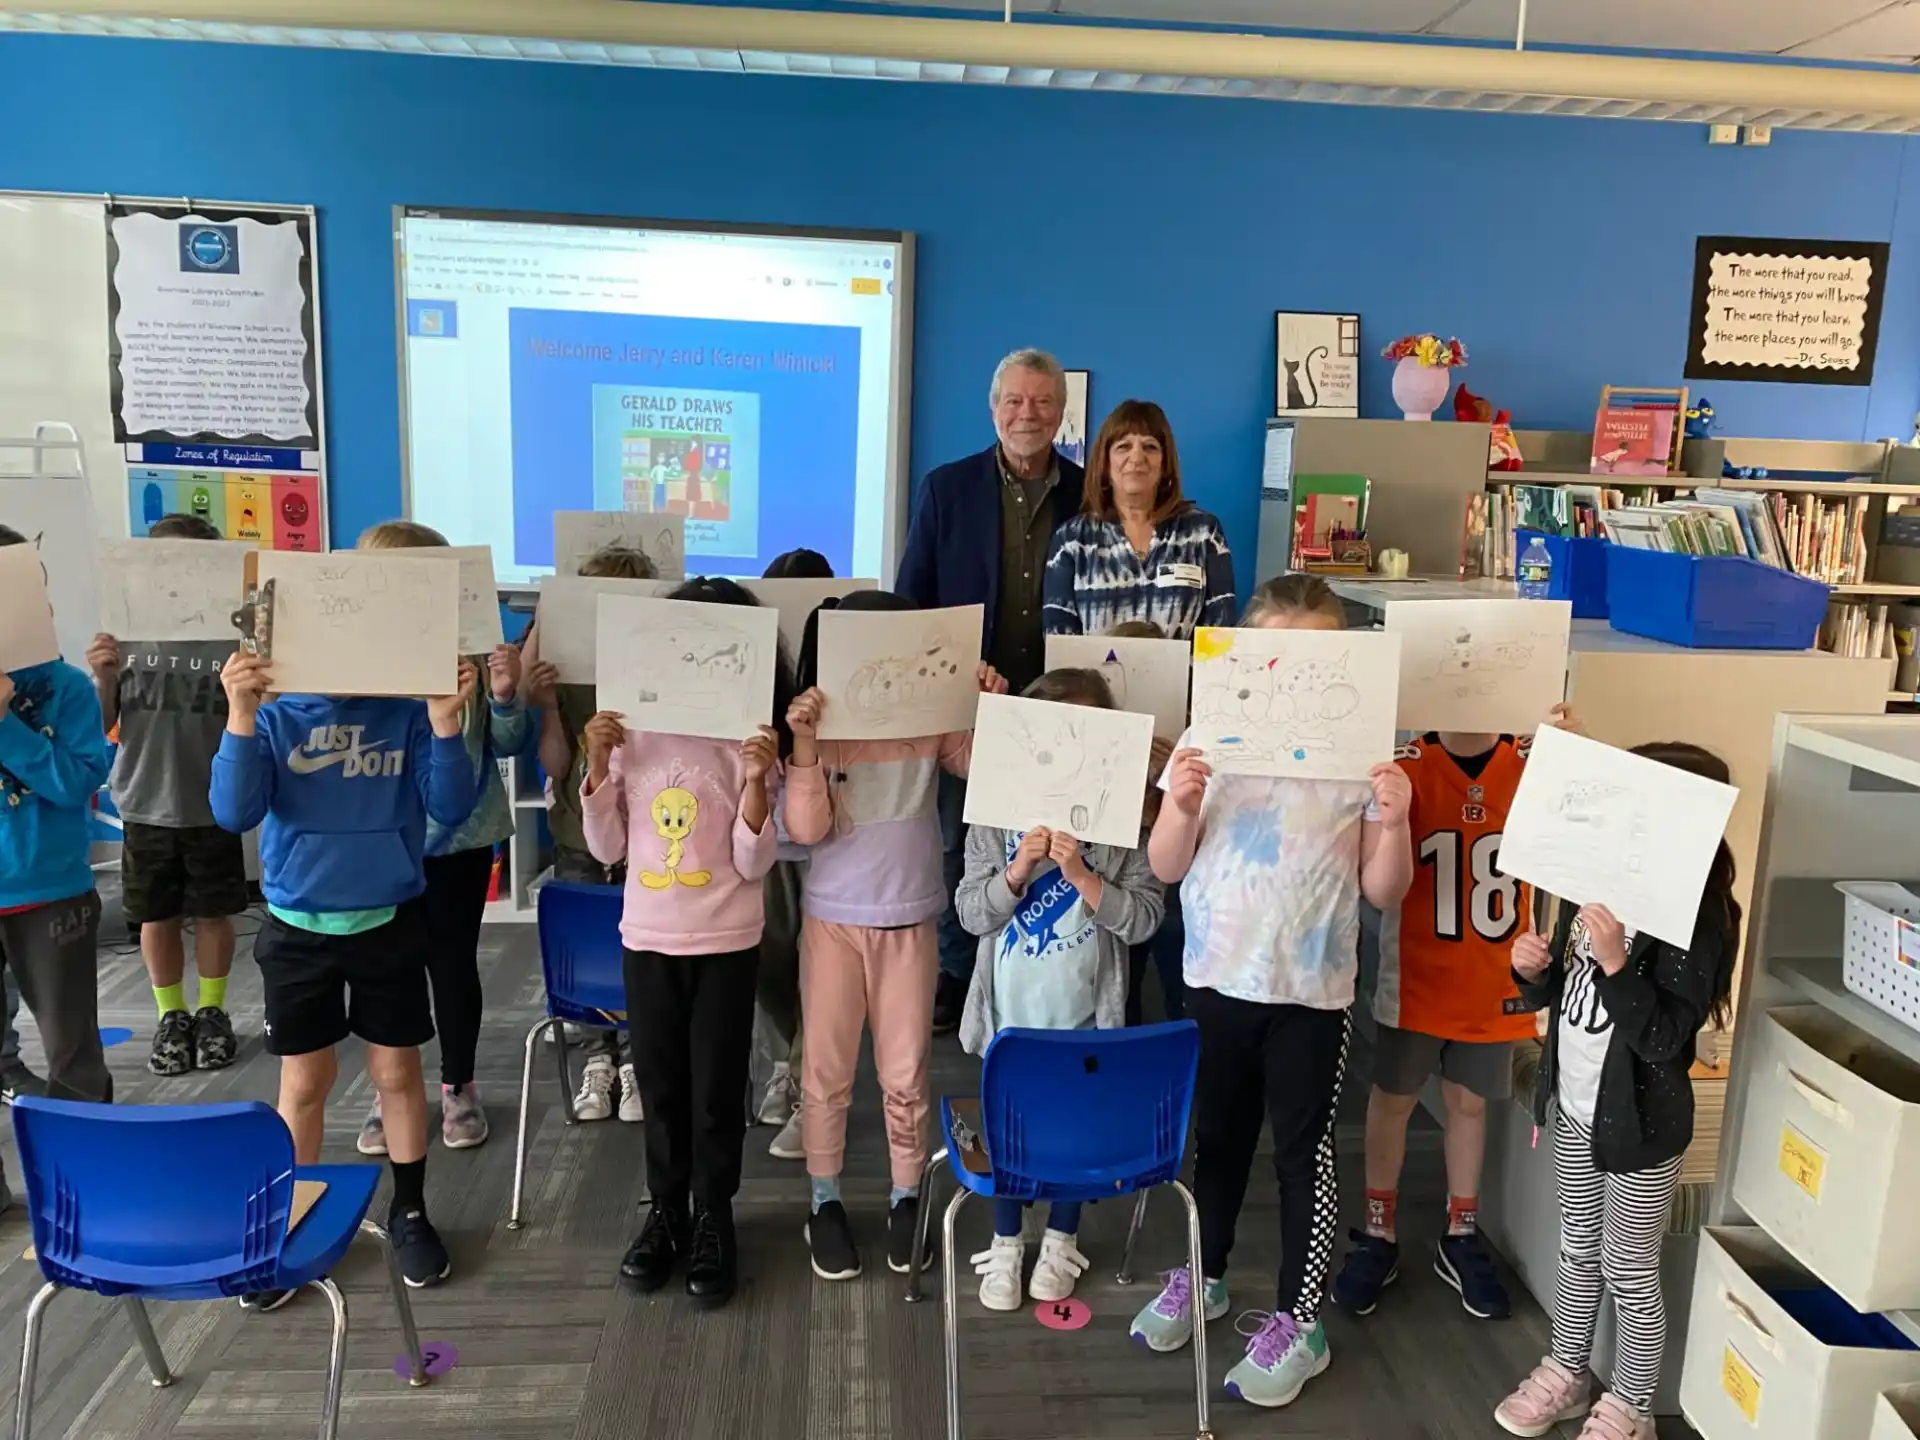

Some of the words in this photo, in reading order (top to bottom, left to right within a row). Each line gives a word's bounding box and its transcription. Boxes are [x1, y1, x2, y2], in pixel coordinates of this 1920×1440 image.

[1729, 263, 1751, 278] The
[1755, 268, 1779, 278] more
[1781, 267, 1804, 280] that
[1806, 270, 1824, 283] you
[1711, 286, 1729, 298] the
[1732, 288, 1756, 298] more
[1758, 287, 1793, 304] things
[1795, 290, 1813, 303] you
[1816, 288, 1835, 301] will
[1723, 307, 1746, 321] The
[1749, 312, 1773, 322] more
[1775, 311, 1799, 324] that
[1801, 313, 1819, 326] you
[1714, 329, 1733, 342] the
[1735, 333, 1760, 343] more
[1762, 330, 1796, 347] places
[1798, 335, 1817, 348] you
[1820, 332, 1838, 346] will
[527, 336, 613, 361] Welcome
[617, 342, 666, 369] Jerry
[671, 346, 705, 366] and
[710, 347, 765, 370] Karen
[1820, 352, 1850, 365] Seuss
[620, 394, 677, 413] GERALD
[683, 396, 733, 414] DRAWS
[631, 413, 655, 430] HIS
[659, 414, 723, 433] TEACHER
[174, 446, 204, 459] Zones
[206, 449, 219, 462] of
[222, 447, 274, 464] Regulation
[126, 654, 221, 673] FUTUR
[303, 724, 365, 753] JUST
[1419, 829, 1521, 943] 18
[1020, 877, 1073, 928] ROCKE
[1057, 928, 1095, 952] ELEM
[1052, 1303, 1073, 1322] 4
